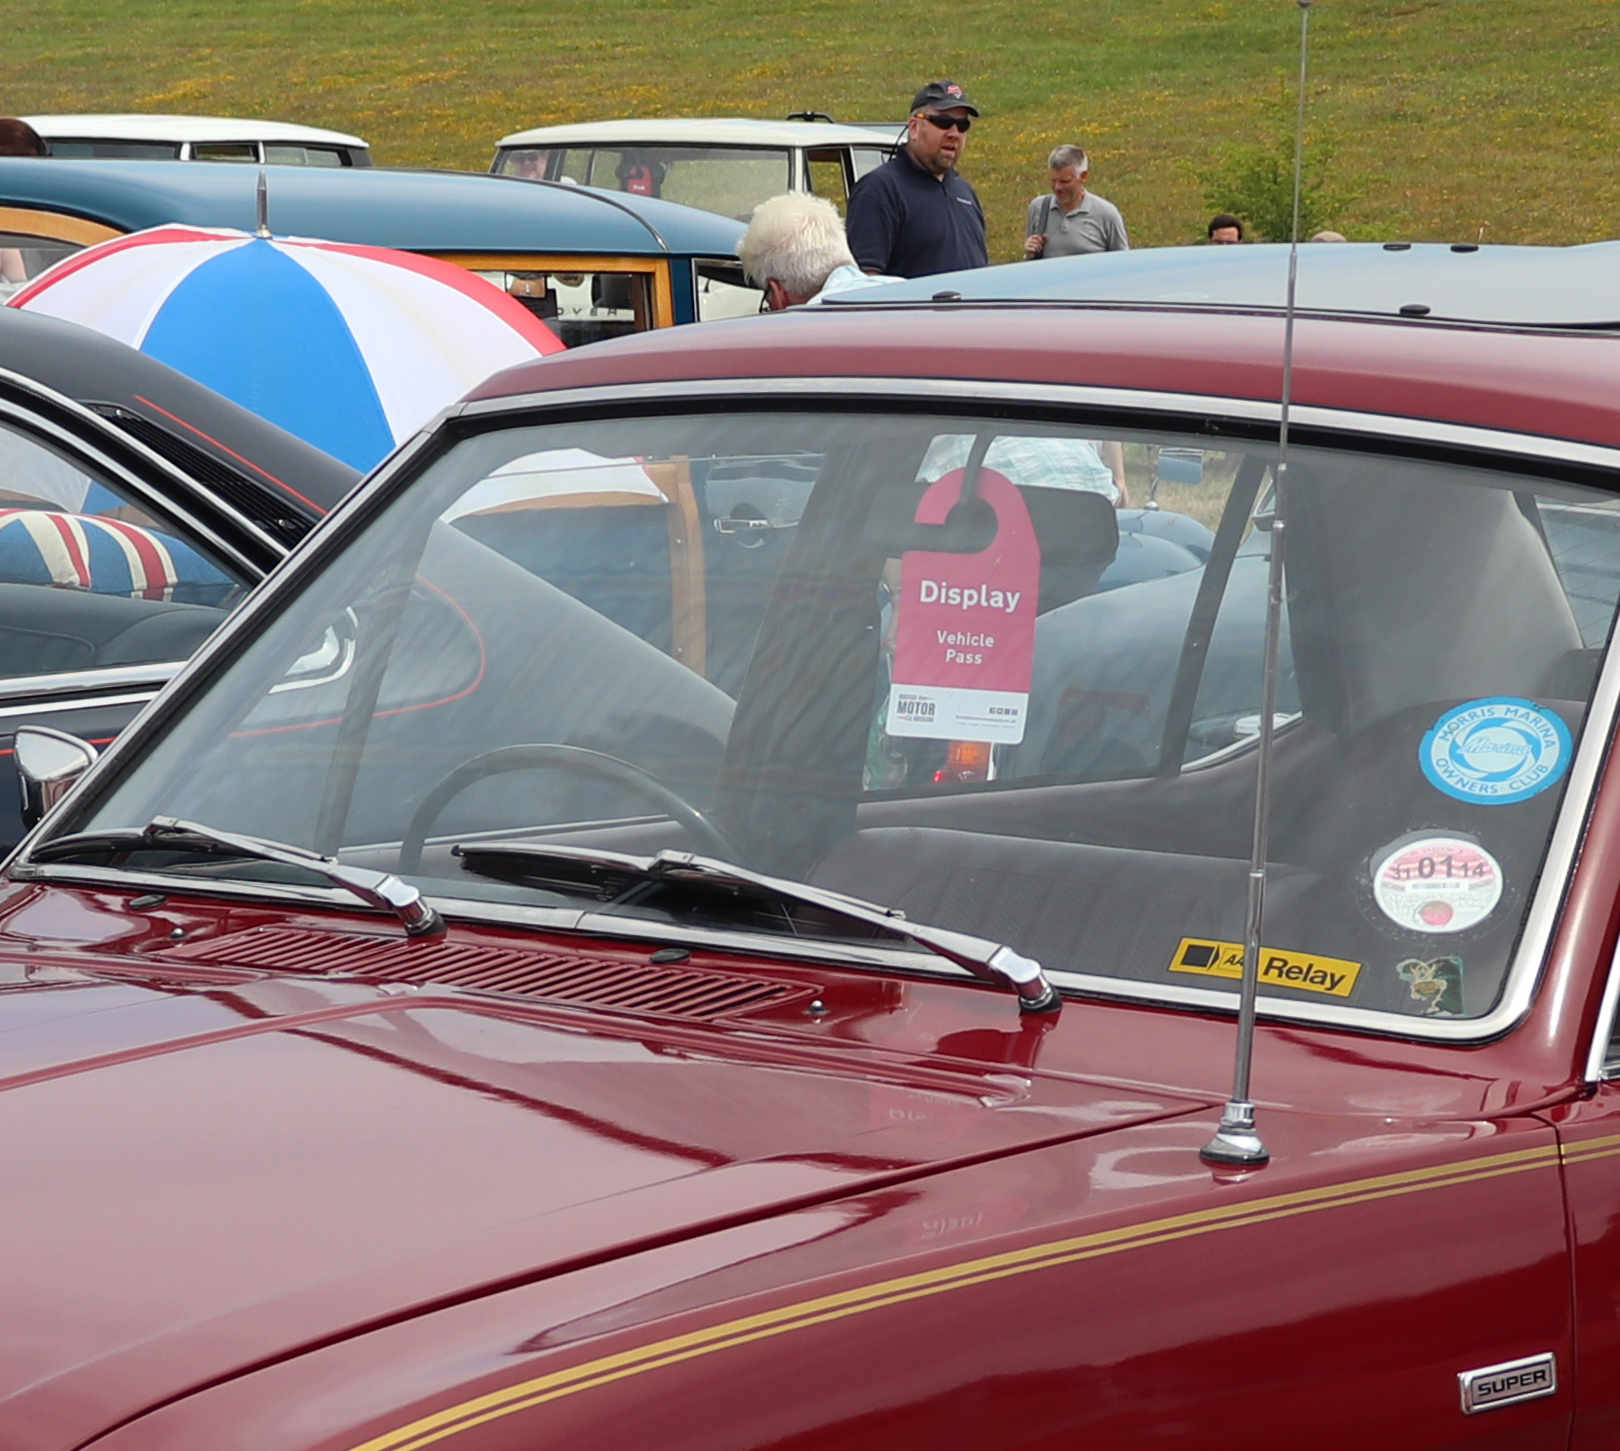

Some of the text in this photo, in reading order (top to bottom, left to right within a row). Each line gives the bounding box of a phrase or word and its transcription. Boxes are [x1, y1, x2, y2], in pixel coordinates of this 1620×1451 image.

[557, 307, 617, 316] OVER
[919, 580, 1020, 613] Display
[937, 630, 995, 648] Vehicle
[945, 649, 983, 665] Pass
[896, 700, 936, 717] MOTOR
[1439, 706, 1557, 749] MORRIS MARINA
[1435, 757, 1549, 794] OWNERS CLUB
[1392, 855, 1486, 881] 31 01 14
[1262, 956, 1346, 992] Relay
[1478, 1369, 1548, 1397] SUPER
